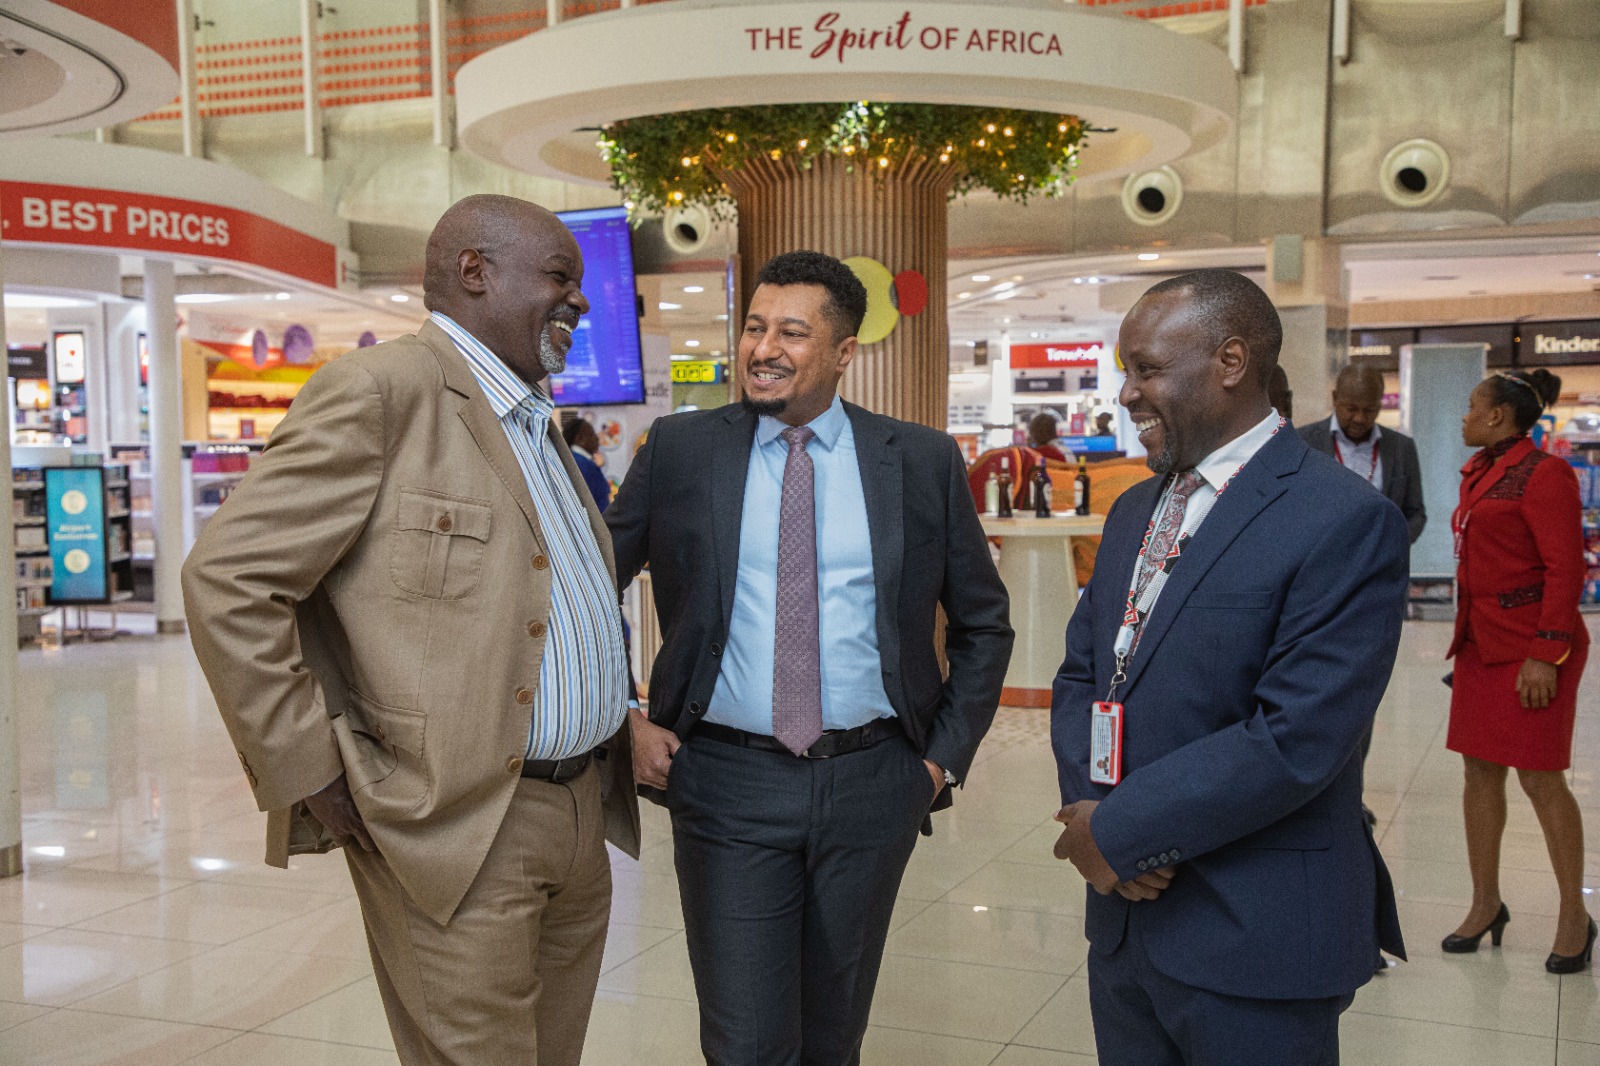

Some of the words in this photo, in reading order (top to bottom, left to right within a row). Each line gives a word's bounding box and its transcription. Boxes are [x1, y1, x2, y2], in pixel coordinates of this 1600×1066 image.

[745, 26, 802, 50] THE
[810, 11, 913, 63] Spirit
[920, 26, 959, 50] OF
[965, 28, 1063, 57] AFRICA
[22, 197, 118, 233] BEST
[126, 206, 230, 247] PRICES
[1535, 334, 1600, 354] Kinder
